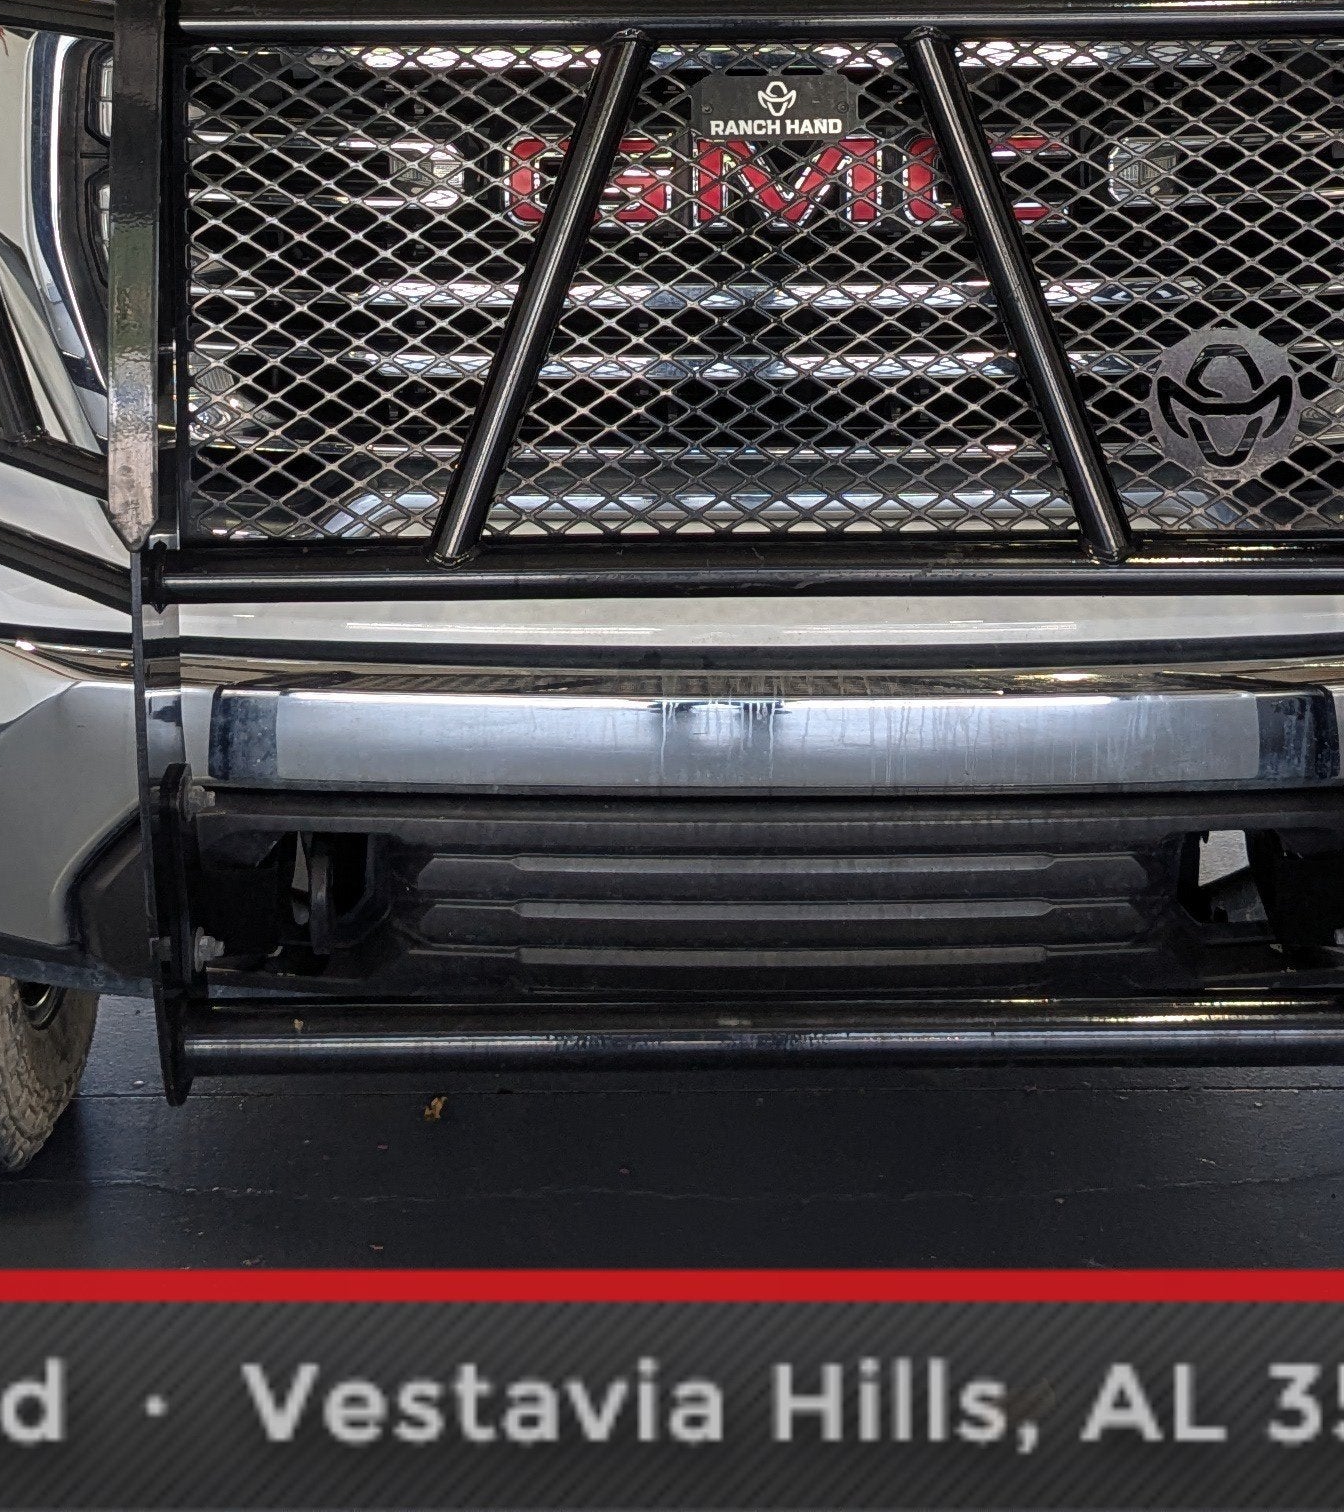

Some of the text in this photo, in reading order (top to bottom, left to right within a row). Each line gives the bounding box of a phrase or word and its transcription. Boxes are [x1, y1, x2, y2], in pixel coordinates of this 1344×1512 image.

[710, 119, 842, 135] RANCH HAND
[504, 136, 1069, 227] GMC
